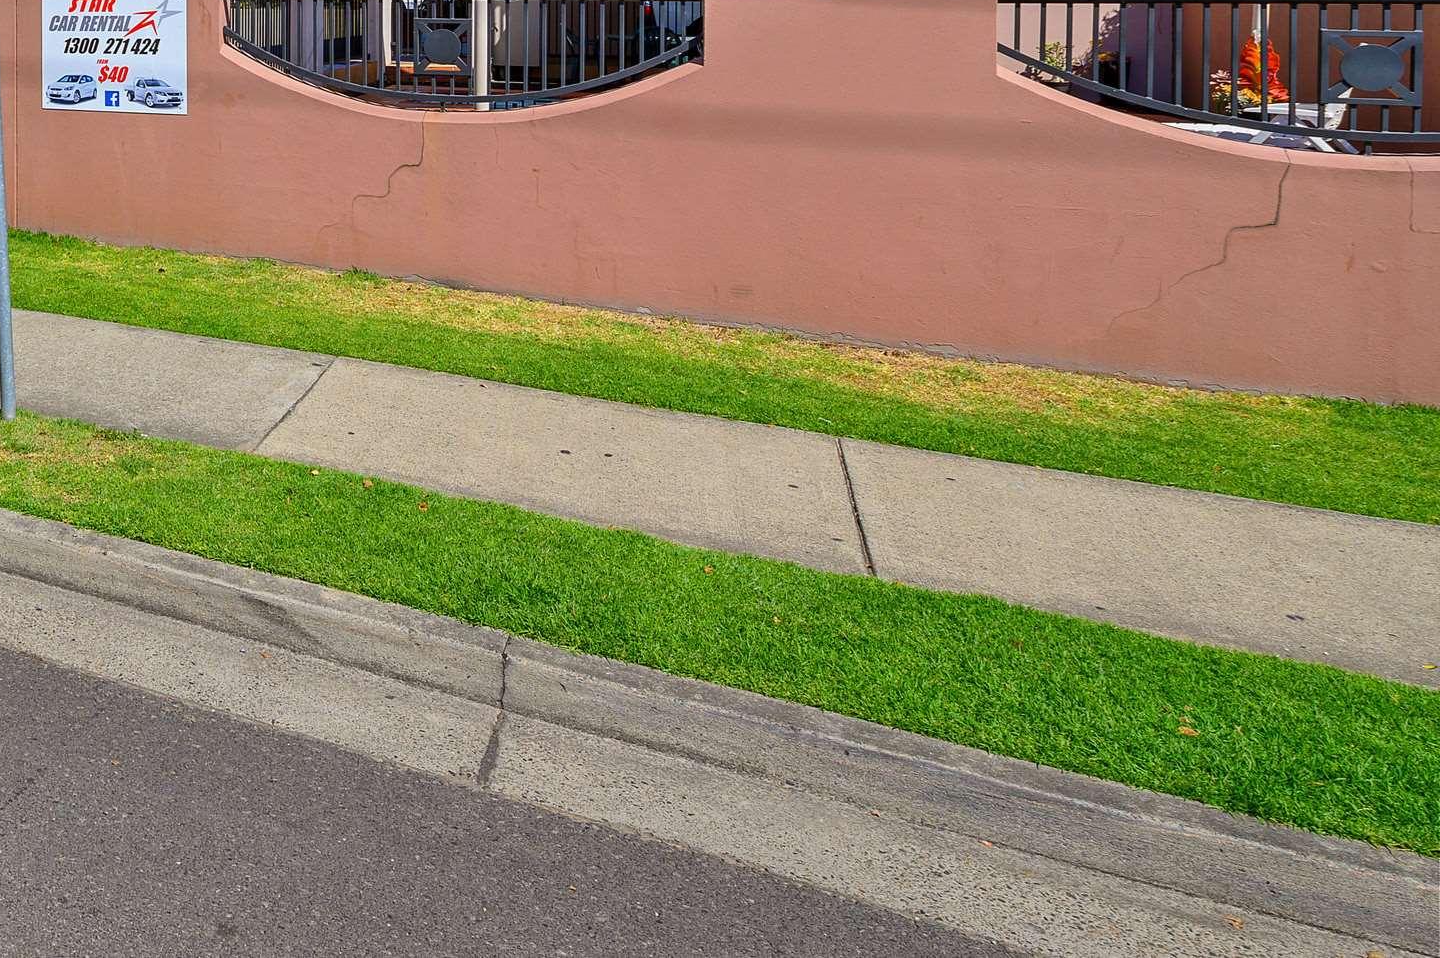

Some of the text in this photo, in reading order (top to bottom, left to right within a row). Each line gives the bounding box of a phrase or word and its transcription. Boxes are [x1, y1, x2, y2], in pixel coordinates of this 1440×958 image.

[48, 15, 132, 32] CAR RENTAL
[63, 37, 161, 55] 1300 271 424
[97, 65, 129, 84] $40
